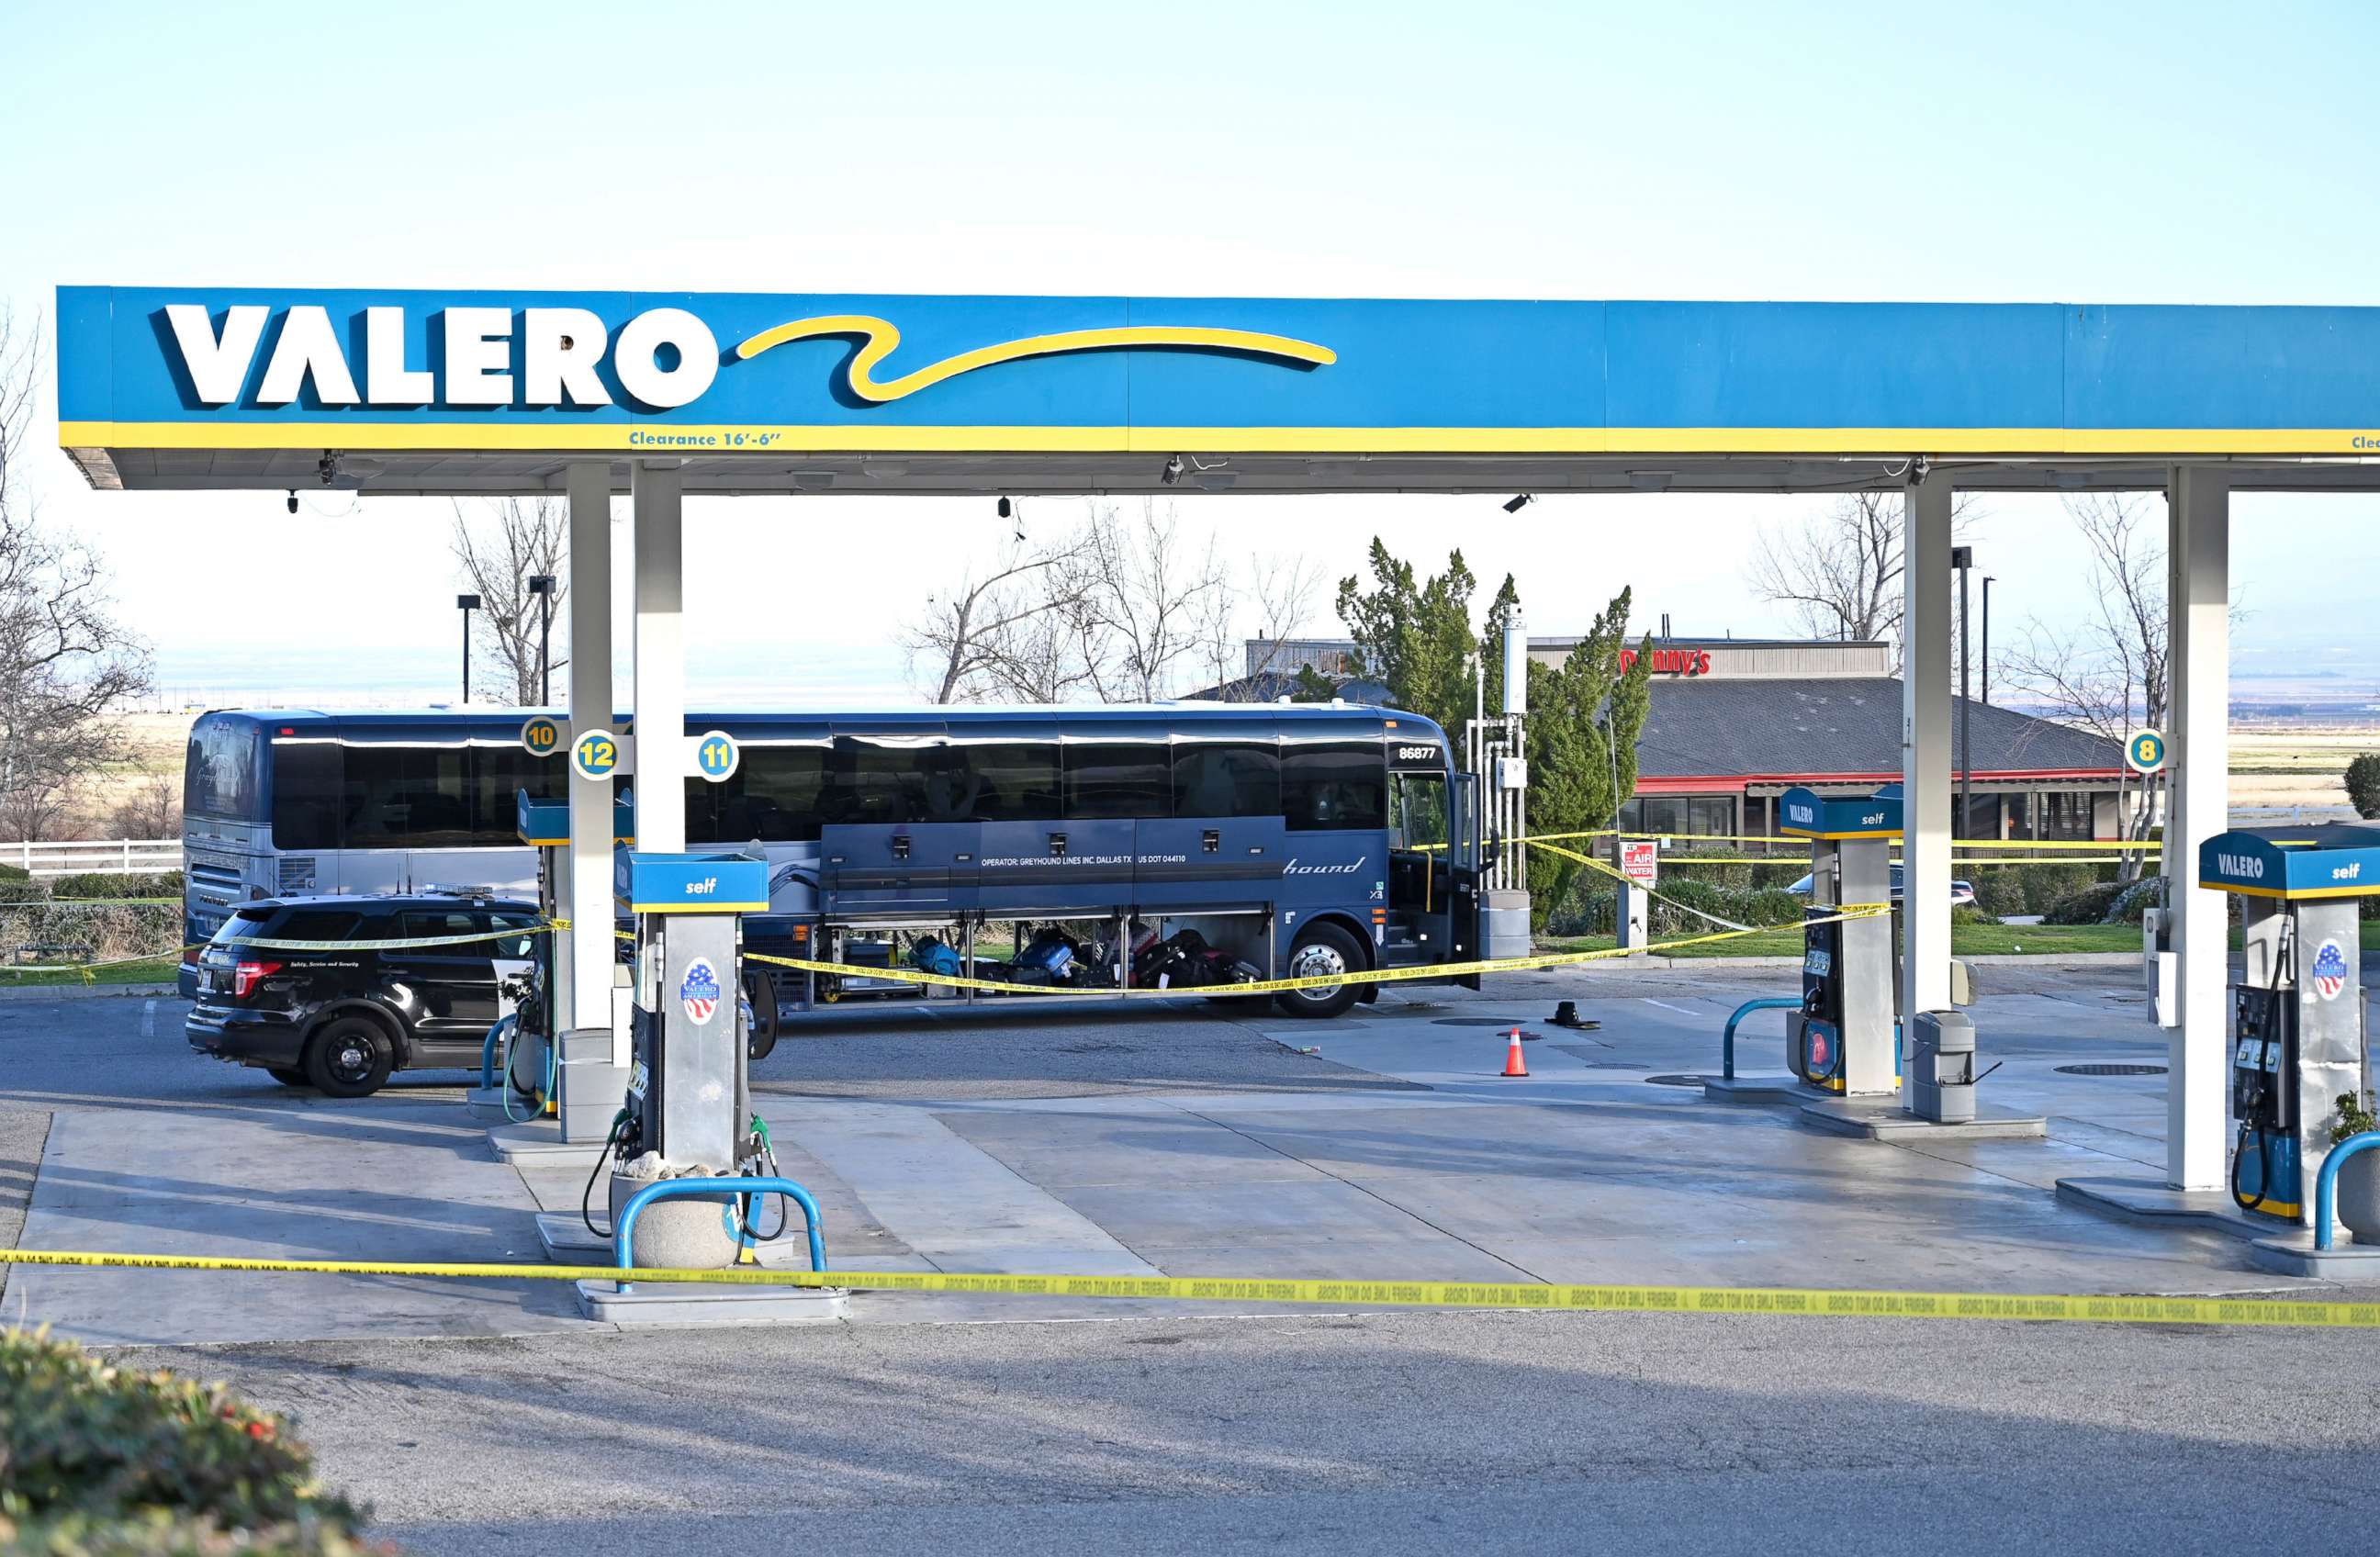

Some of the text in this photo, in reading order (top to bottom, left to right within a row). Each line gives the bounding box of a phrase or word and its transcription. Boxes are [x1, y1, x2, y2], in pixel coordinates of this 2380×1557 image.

[165, 304, 720, 408] VALERO
[629, 431, 716, 445] Clearance
[1619, 648, 1711, 677] Dnny's
[529, 727, 554, 745] 10
[580, 742, 613, 766] 12
[703, 744, 728, 767] 11
[1399, 747, 1436, 760] 86877
[2139, 739, 2156, 762] 8
[1789, 804, 1813, 823] VALERO
[1861, 813, 1885, 825] self
[1020, 857, 1061, 866] GREYHOUND
[1063, 857, 1081, 865] LINES
[1283, 857, 1366, 874] hound
[1634, 853, 1652, 863] AIR
[2218, 853, 2264, 879] VALERO
[2332, 863, 2360, 879] self
[685, 878, 717, 894] self
